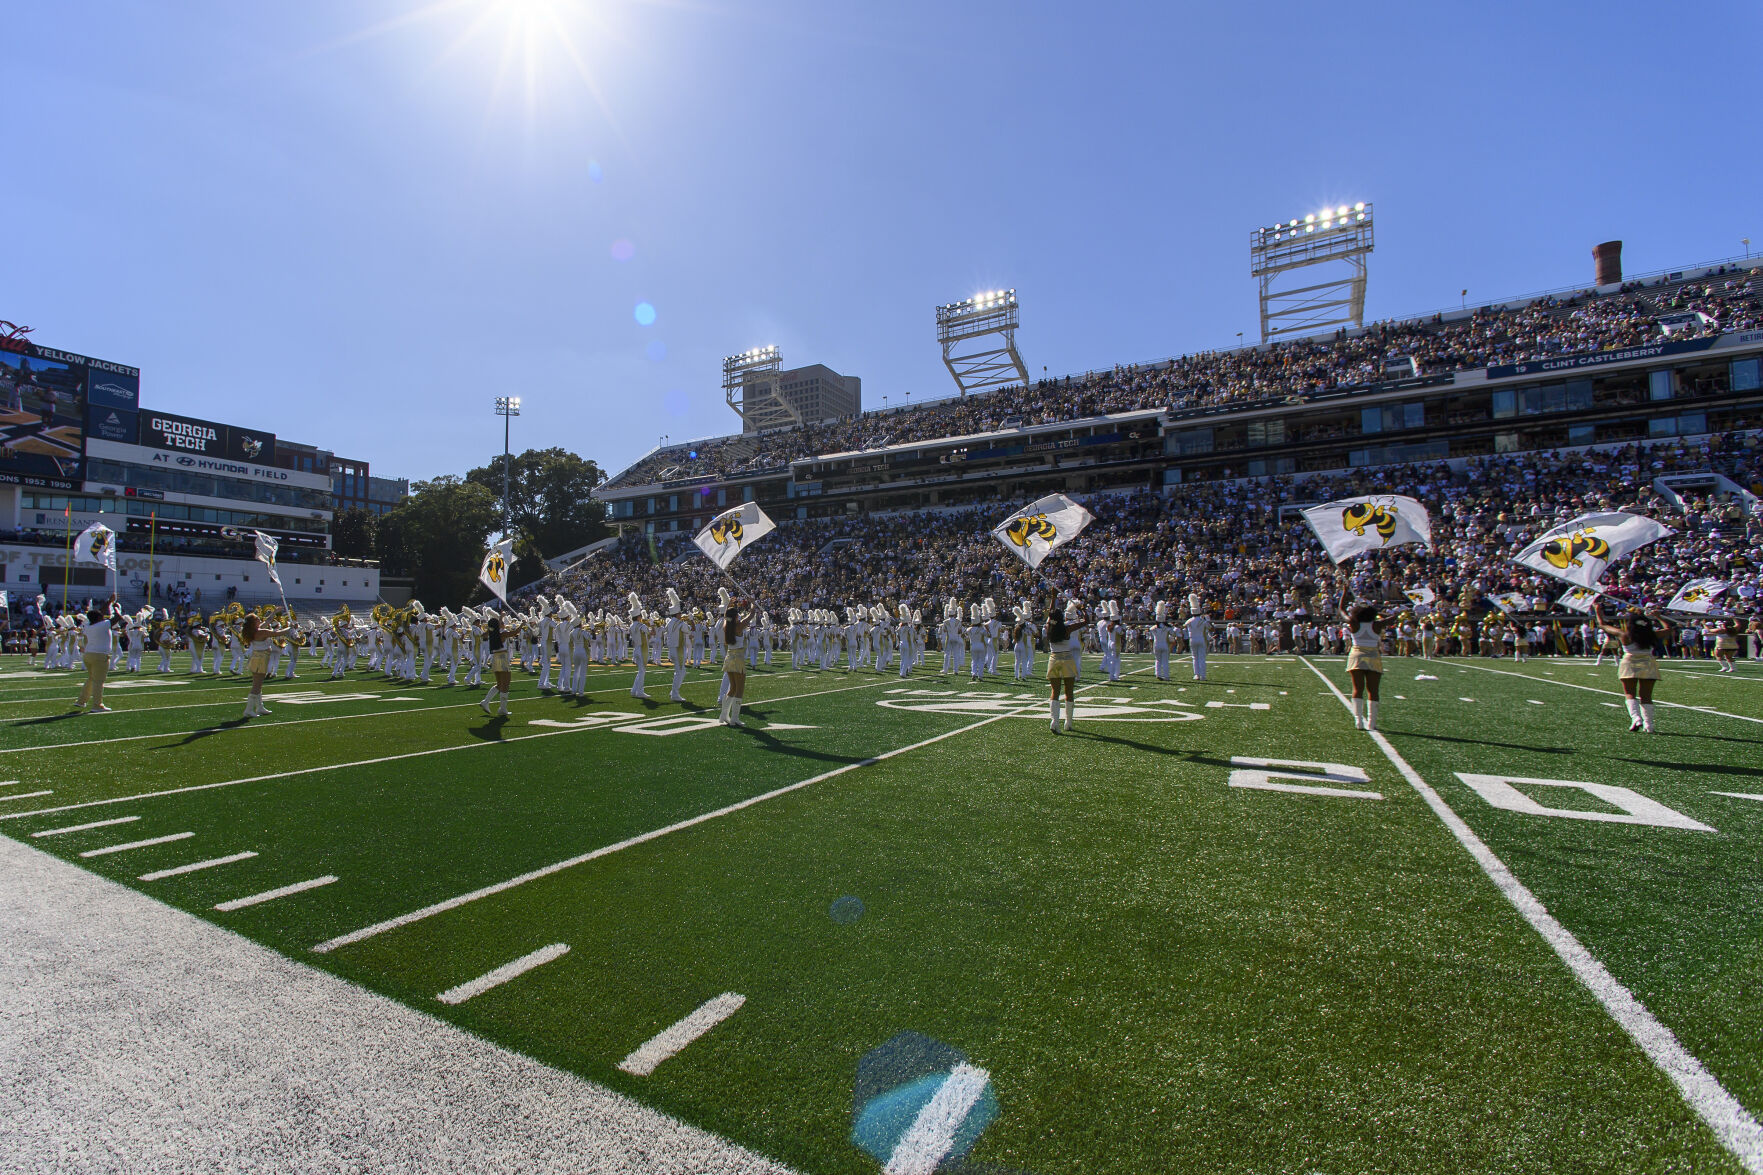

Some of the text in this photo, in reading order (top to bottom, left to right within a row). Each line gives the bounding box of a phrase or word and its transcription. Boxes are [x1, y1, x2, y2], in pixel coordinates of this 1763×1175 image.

[36, 346, 138, 377] YELLOW JACKETS
[1542, 359, 1575, 370] CLINT
[1578, 347, 1664, 365] CASTLEBERRY
[152, 418, 217, 440] GEORGIA
[164, 433, 206, 451] TECH
[1058, 439, 1080, 448] TECH
[153, 453, 288, 480] AT HYUNDAI FIELD
[24, 478, 46, 486] 1952
[50, 480, 72, 489] 1990
